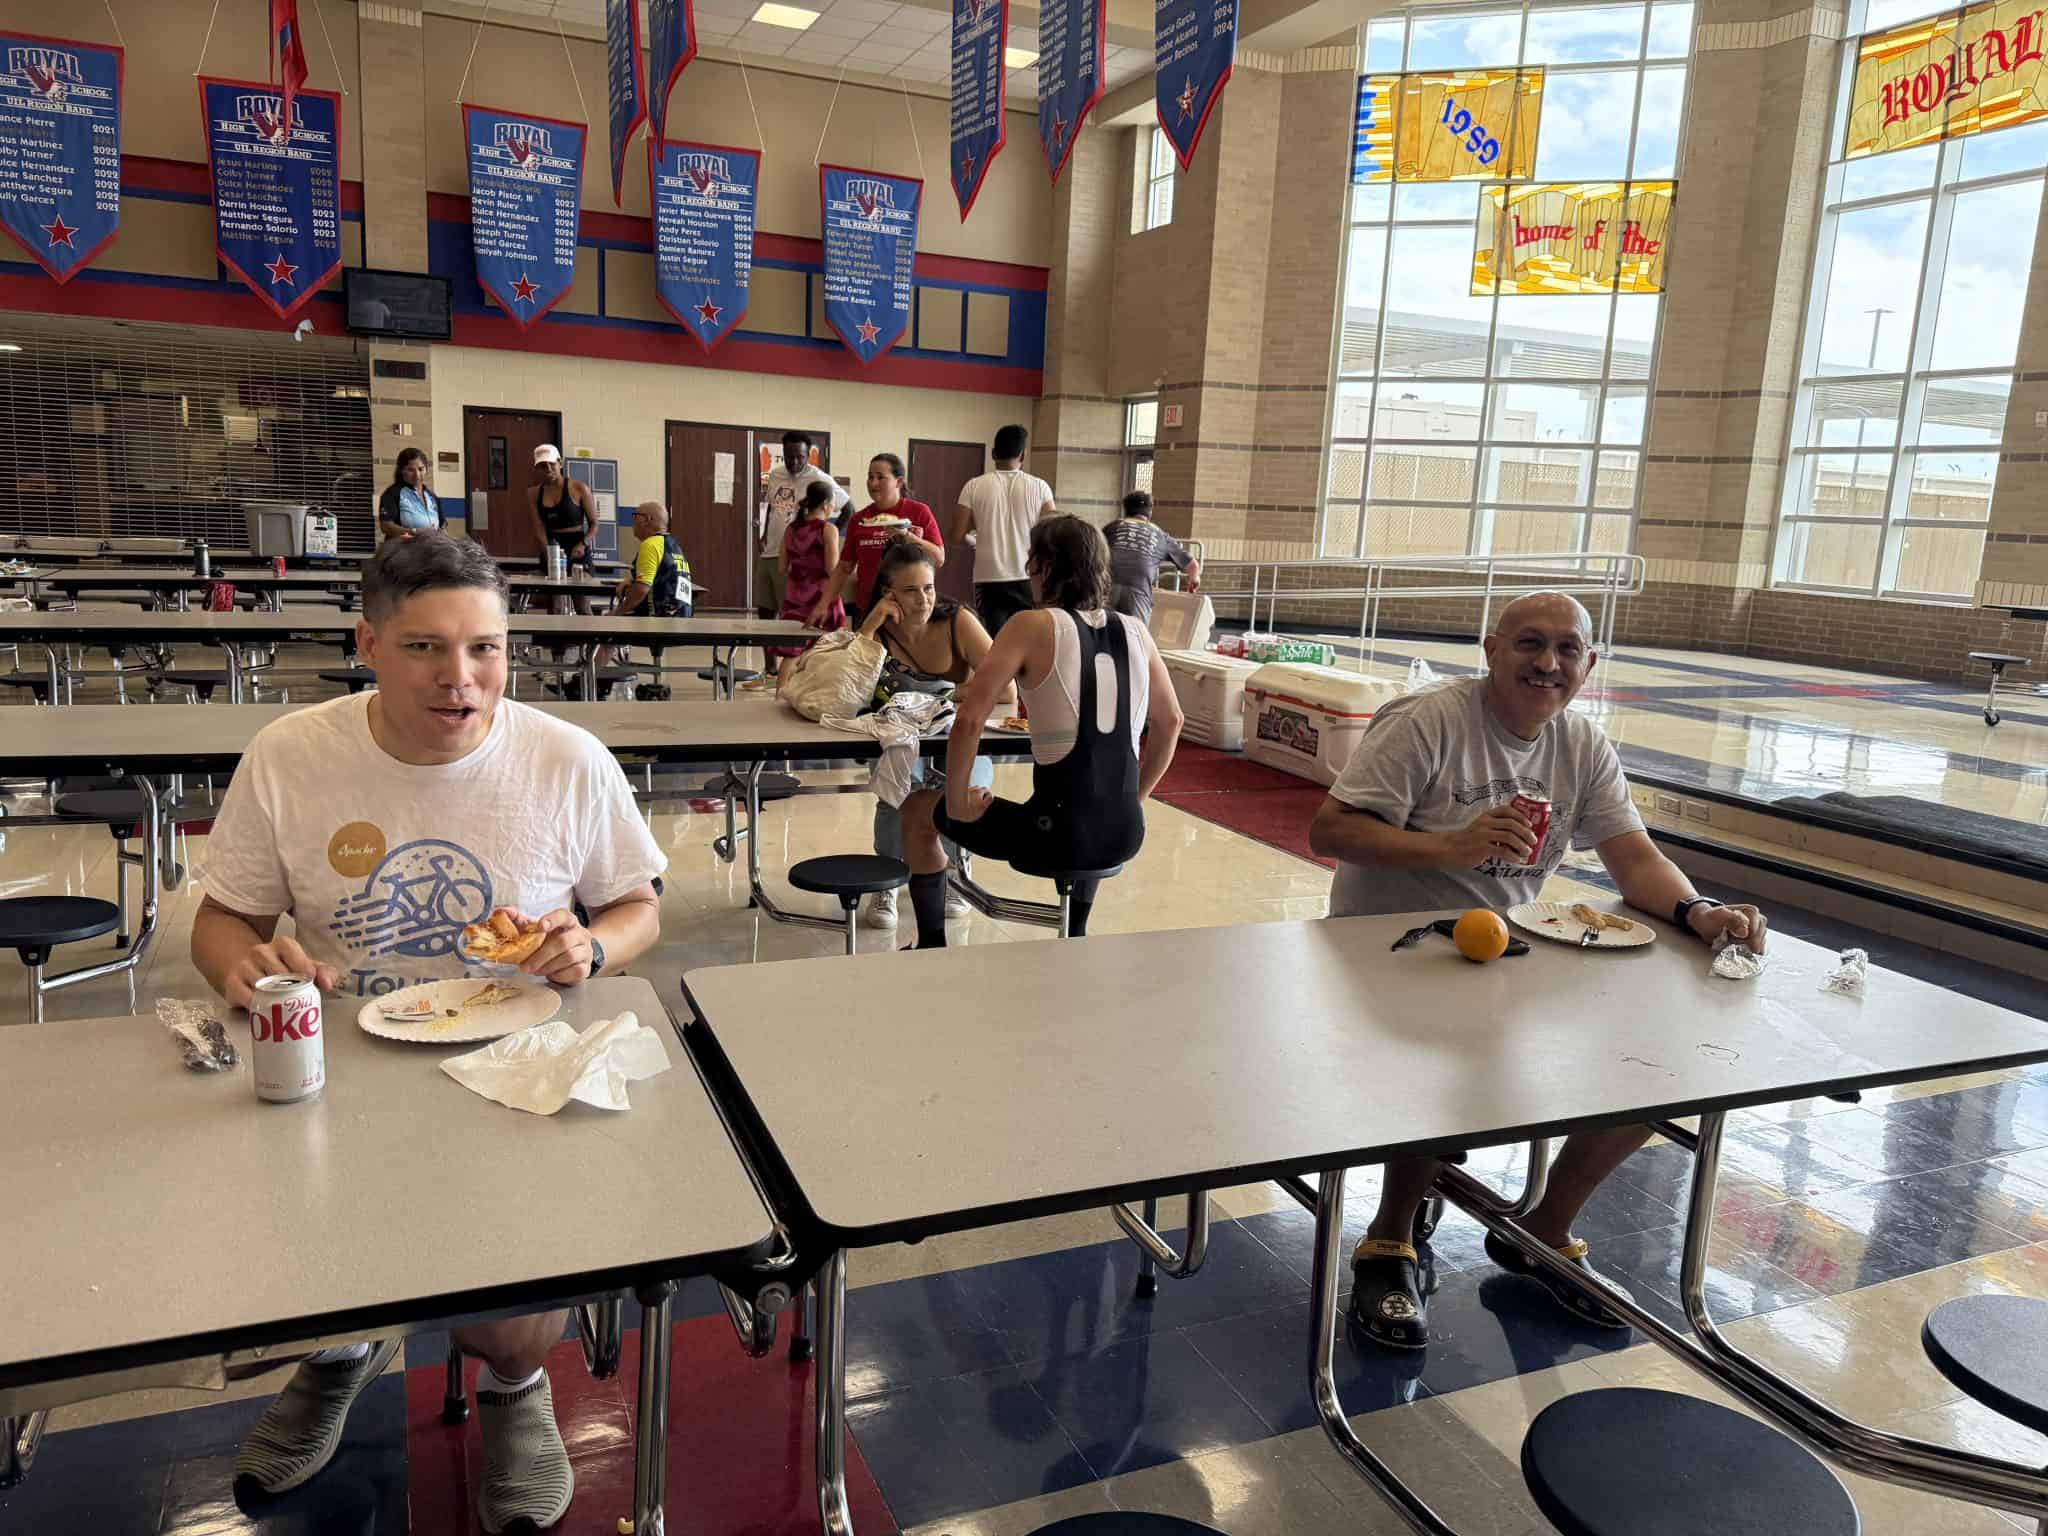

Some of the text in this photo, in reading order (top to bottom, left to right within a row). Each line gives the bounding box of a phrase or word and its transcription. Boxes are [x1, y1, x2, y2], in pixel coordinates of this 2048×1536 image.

[8, 47, 83, 83] ROYAL
[71, 85, 108, 97] SCHOOL
[28, 99, 63, 112] REGION
[66, 103, 93, 115] BAND
[236, 95, 304, 129] ROYL
[26, 116, 55, 128] Pierre
[221, 122, 328, 143] HIGH SCHOOL
[494, 123, 553, 155] ROYAL
[20, 138, 64, 150] Martinez
[22, 148, 54, 160] Turner
[288, 149, 312, 159] BAND
[21, 160, 75, 174] Hernandez
[542, 157, 574, 169] SCHOOL
[678, 153, 731, 184] ROYAL
[22, 171, 64, 184] Sanchez
[39, 184, 73, 197] Segura
[472, 184, 496, 196] Jacob
[847, 180, 894, 208] ROYAL
[21, 193, 55, 205] Garces
[219, 199, 247, 209] Darrin
[250, 201, 288, 213] Houston
[220, 210, 259, 220] Matthew
[262, 211, 293, 224] Segura
[496, 209, 540, 223] Hernandez
[221, 220, 263, 231] Fernando
[266, 223, 299, 234] Solorio
[1512, 214, 1576, 247] home
[1583, 218, 1607, 250] of
[503, 230, 528, 241] Turner
[350, 968, 439, 997] TO
